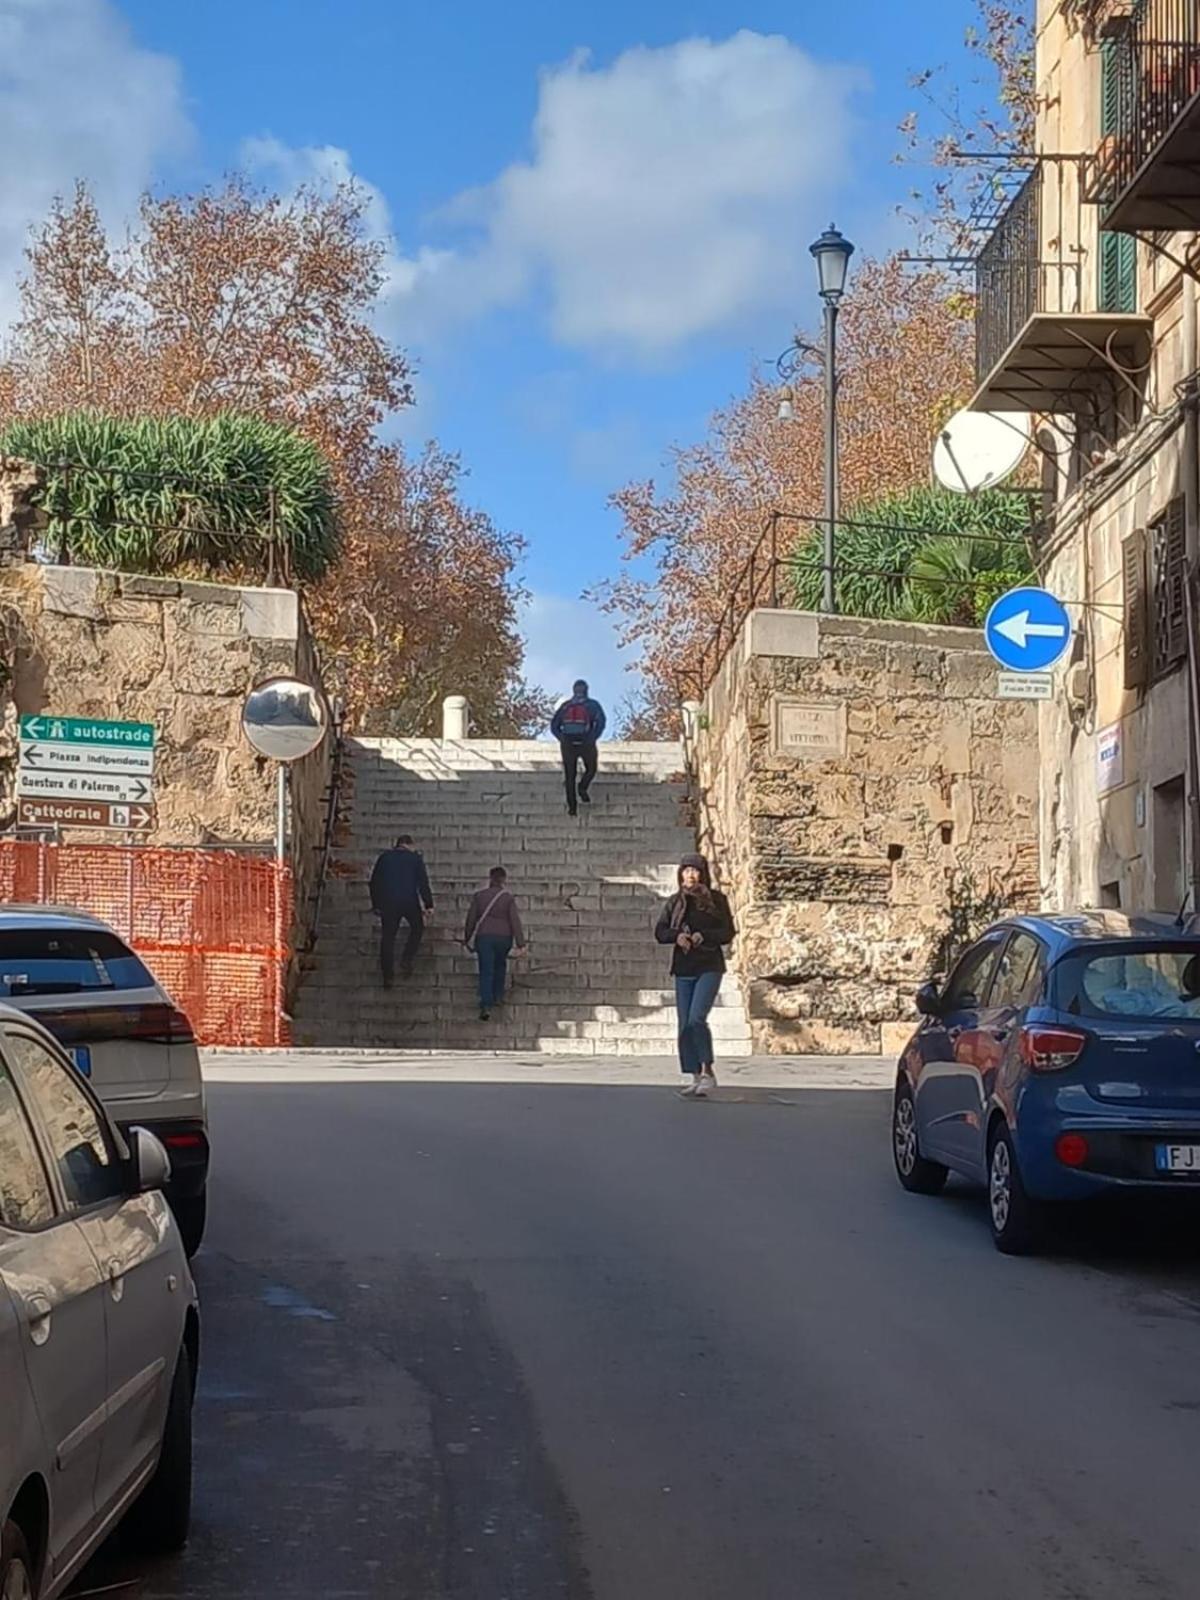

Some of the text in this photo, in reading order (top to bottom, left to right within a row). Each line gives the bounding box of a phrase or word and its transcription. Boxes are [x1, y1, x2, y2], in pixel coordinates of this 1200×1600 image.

[73, 725, 151, 742] autostrade
[49, 751, 81, 762] Piazza
[21, 776, 120, 793] Questura di Palermo
[22, 803, 101, 820] Cattedrale
